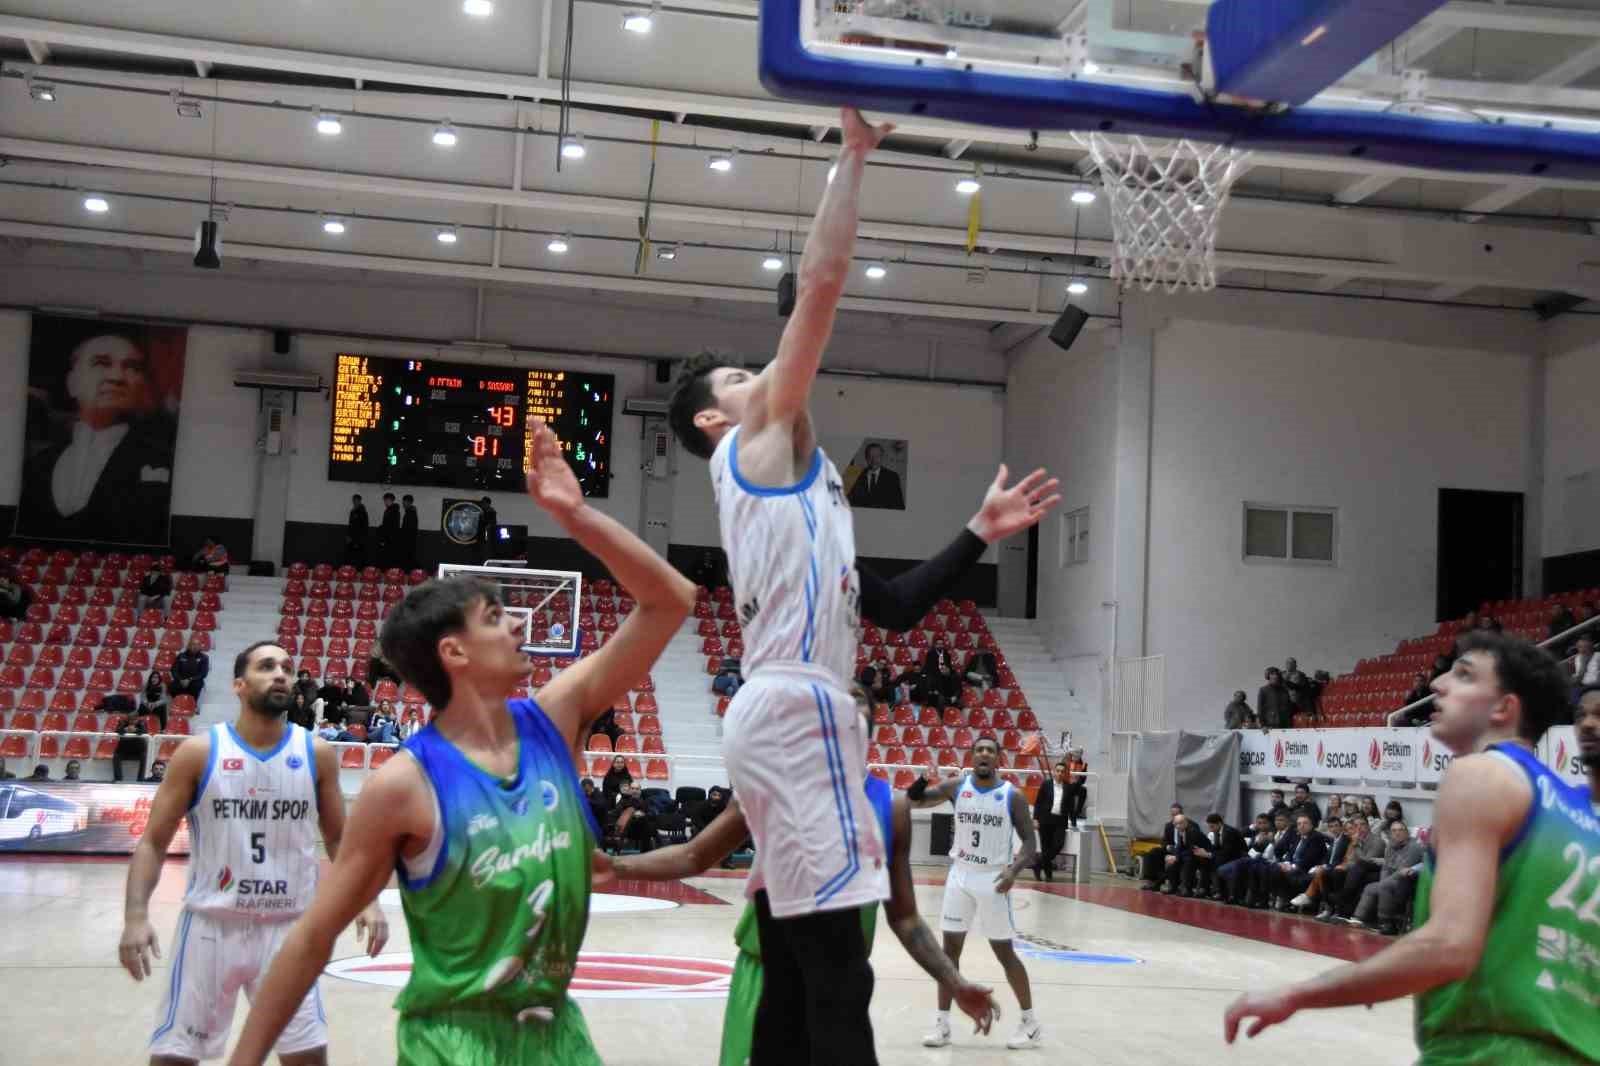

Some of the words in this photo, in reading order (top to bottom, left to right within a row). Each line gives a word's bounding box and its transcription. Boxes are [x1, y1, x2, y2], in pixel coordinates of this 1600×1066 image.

[1382, 741, 1411, 757] Petkim
[1326, 752, 1358, 769] SOCAR
[272, 799, 309, 820] SPOR
[972, 830, 981, 848] 3
[251, 832, 266, 864] 5
[964, 854, 988, 865] STAR
[238, 880, 287, 895] STAR
